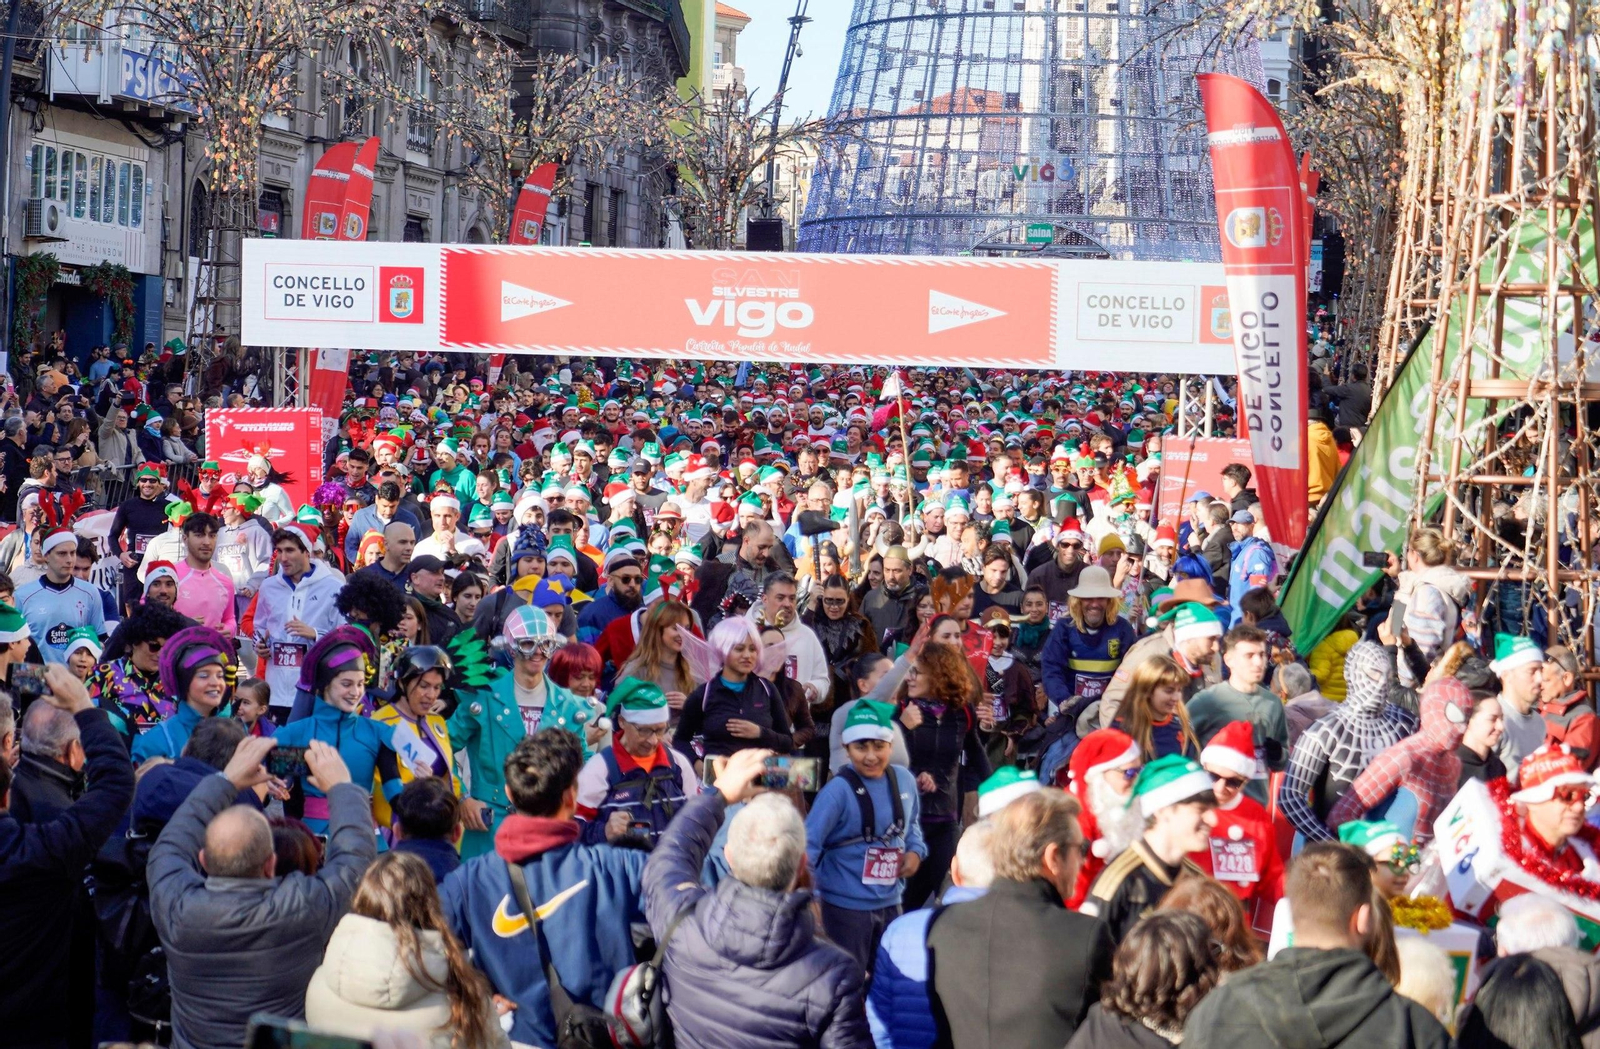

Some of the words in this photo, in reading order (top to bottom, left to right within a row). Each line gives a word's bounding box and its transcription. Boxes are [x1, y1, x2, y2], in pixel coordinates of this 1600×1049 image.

[1027, 227, 1052, 238] SAÍDA
[71, 243, 85, 253] THE
[89, 245, 123, 257] RAINBOW
[273, 275, 366, 291] CONCELLO
[711, 267, 801, 289] SAN
[712, 286, 800, 298] SILVESTRE
[284, 293, 307, 307] DE
[313, 294, 355, 309] VIGO
[503, 295, 511, 305] El
[511, 296, 530, 306] Corte
[529, 295, 557, 309] Inglés
[1086, 294, 1186, 312] CONCELLO
[684, 296, 815, 339] vigo
[931, 305, 940, 316] El
[940, 306, 960, 317] Corte
[960, 305, 990, 319] Inglés
[1098, 313, 1122, 328] DE
[1128, 314, 1174, 330] VIGO
[768, 340, 778, 352] de
[278, 653, 297, 666] 284
